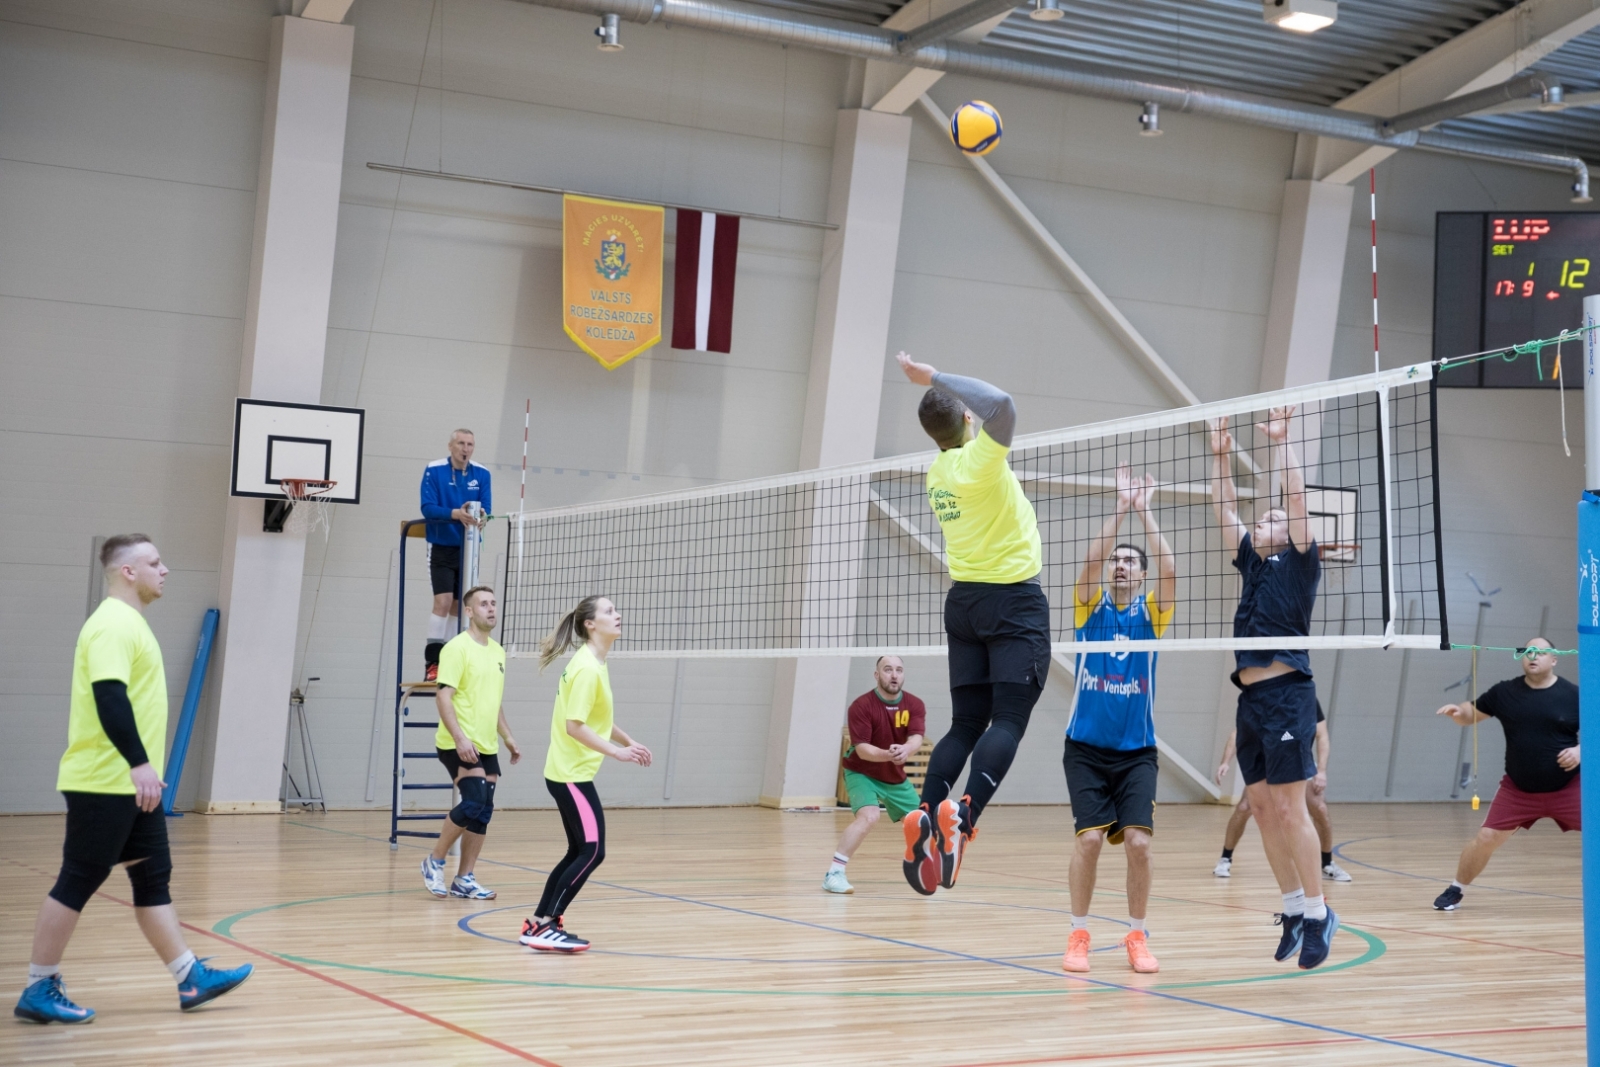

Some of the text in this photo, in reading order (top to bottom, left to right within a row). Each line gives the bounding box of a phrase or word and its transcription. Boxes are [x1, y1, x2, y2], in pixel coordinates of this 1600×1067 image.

[1492, 244, 1515, 255] SET
[1528, 259, 1590, 288] 1 12
[590, 289, 632, 305] VALSTS
[570, 304, 654, 325] ROBEŽSARDZES
[586, 326, 636, 341] KOLEDŽA
[895, 710, 910, 728] 14
